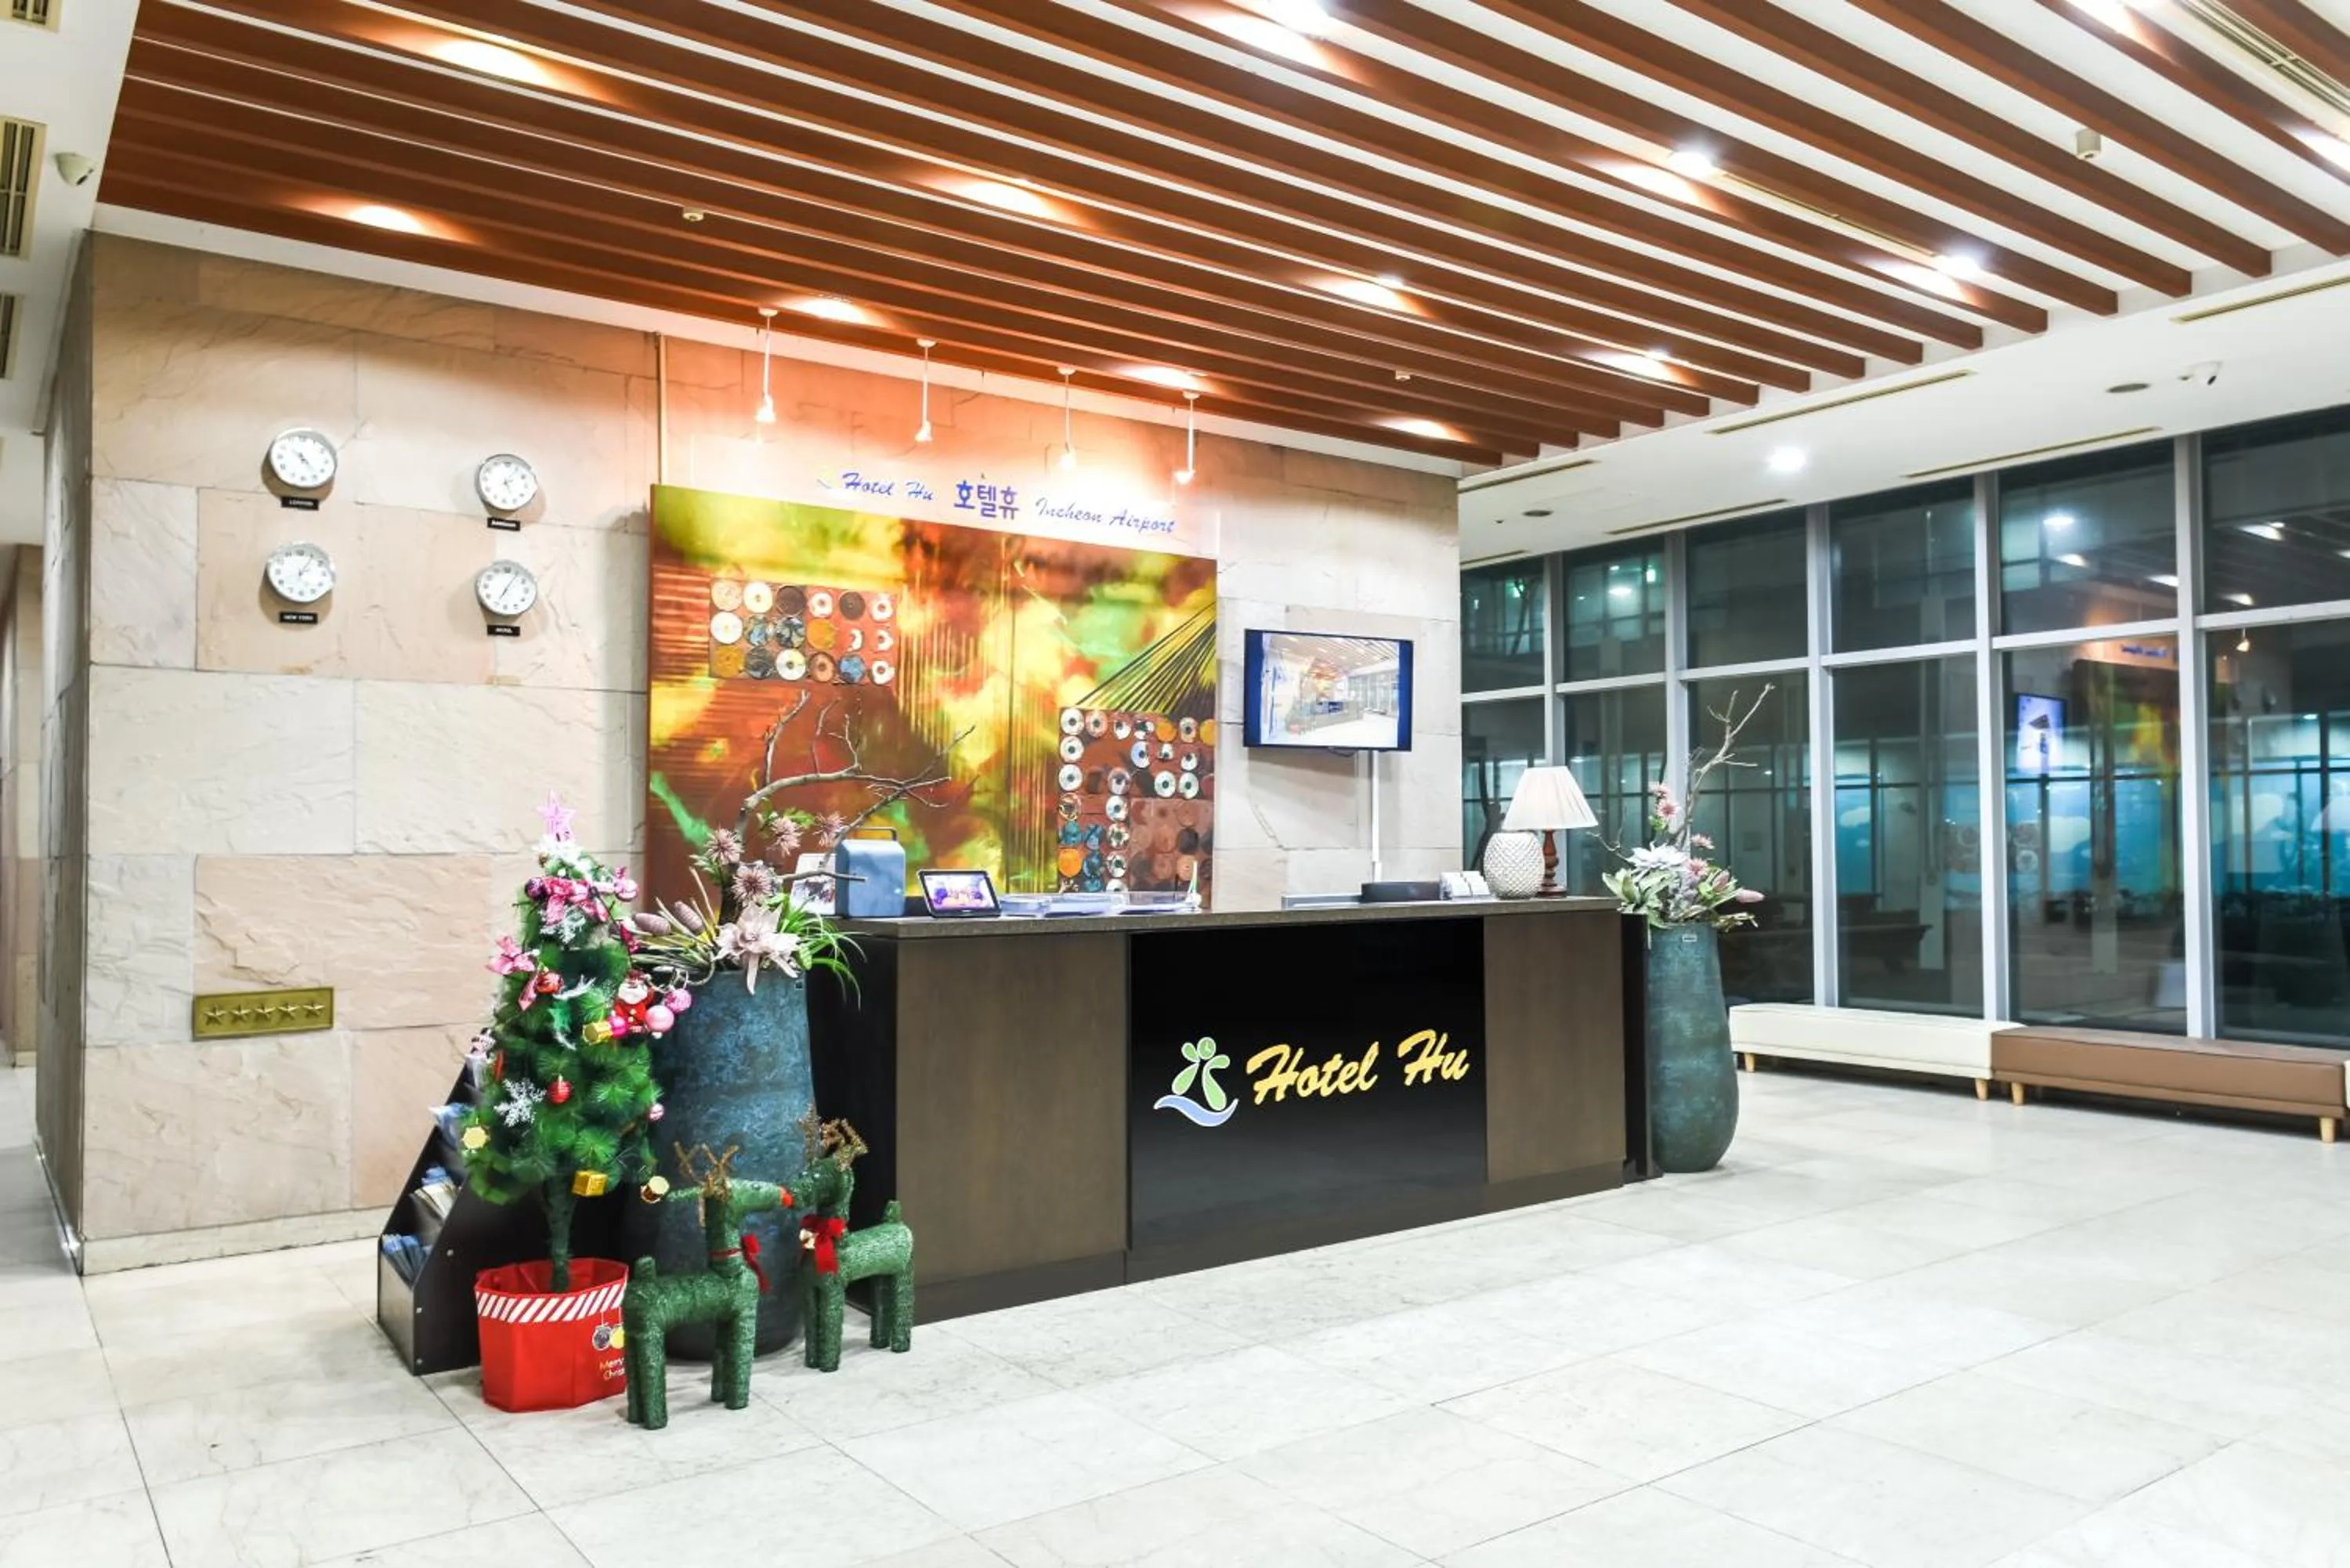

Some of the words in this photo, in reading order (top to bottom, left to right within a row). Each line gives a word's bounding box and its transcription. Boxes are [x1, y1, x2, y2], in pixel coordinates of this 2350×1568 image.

[842, 472, 895, 497] Hotel
[905, 480, 935, 501] Hu
[954, 479, 1020, 520] 호텔휴
[1035, 497, 1104, 523] Incheon
[1109, 508, 1176, 534] Airport
[1246, 1041, 1380, 1106] Hotel
[1397, 1028, 1471, 1086] Hu
